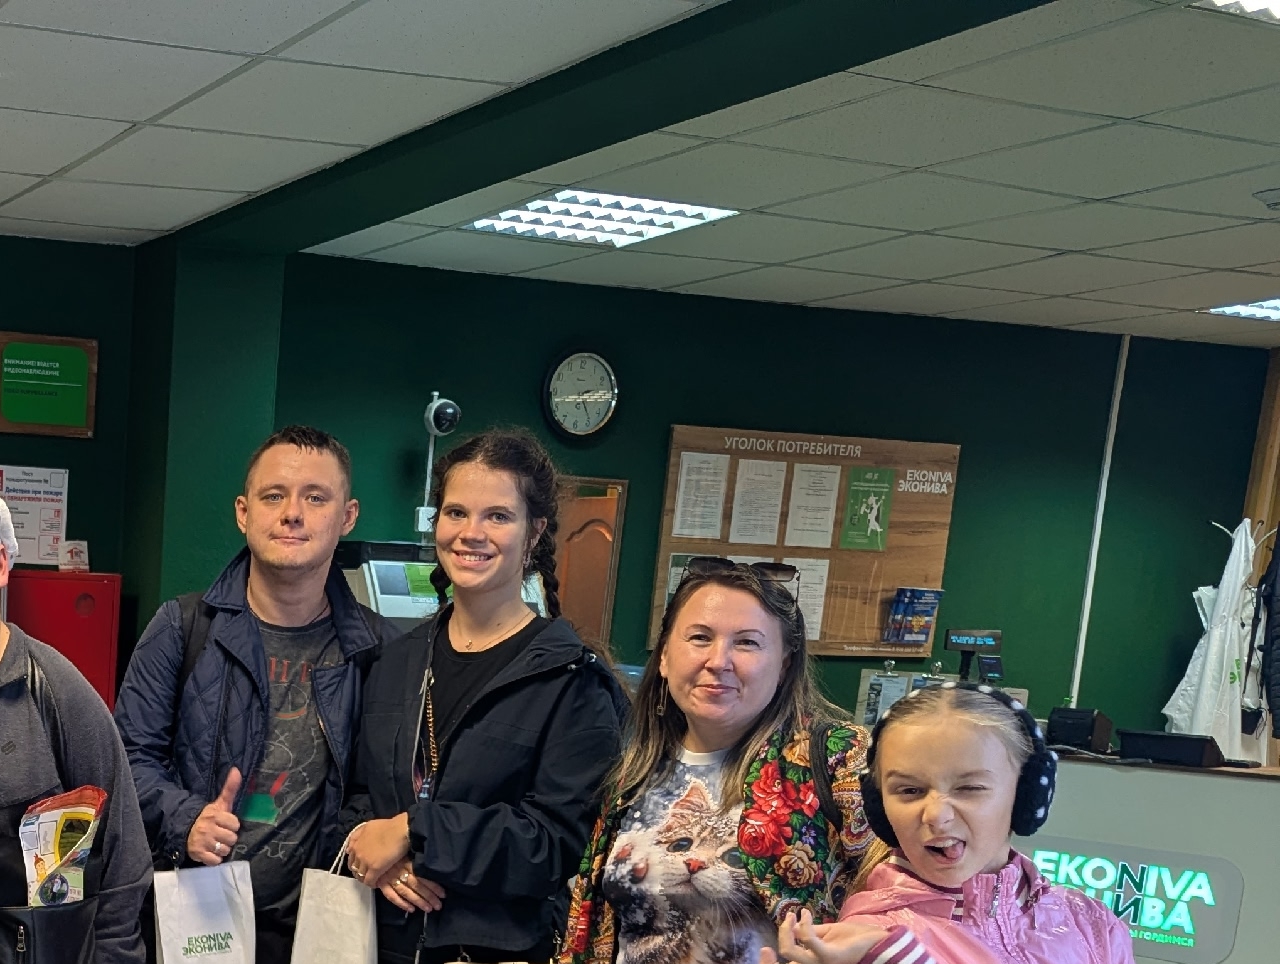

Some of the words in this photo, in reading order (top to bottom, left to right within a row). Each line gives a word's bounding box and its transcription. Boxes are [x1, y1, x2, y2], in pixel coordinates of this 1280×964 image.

[724, 436, 774, 452] УГОЛОК
[776, 440, 862, 458] ПОТРЕБИТЕЛЯ
[906, 469, 953, 484] EKONIVA
[897, 479, 948, 495] ЭКОНИВА
[1033, 850, 1216, 907] EKONIVA
[187, 931, 234, 946] EKONIVA
[1139, 930, 1194, 948] ГОРДИМСЯ
[181, 941, 231, 956] ЭКОНИВА
